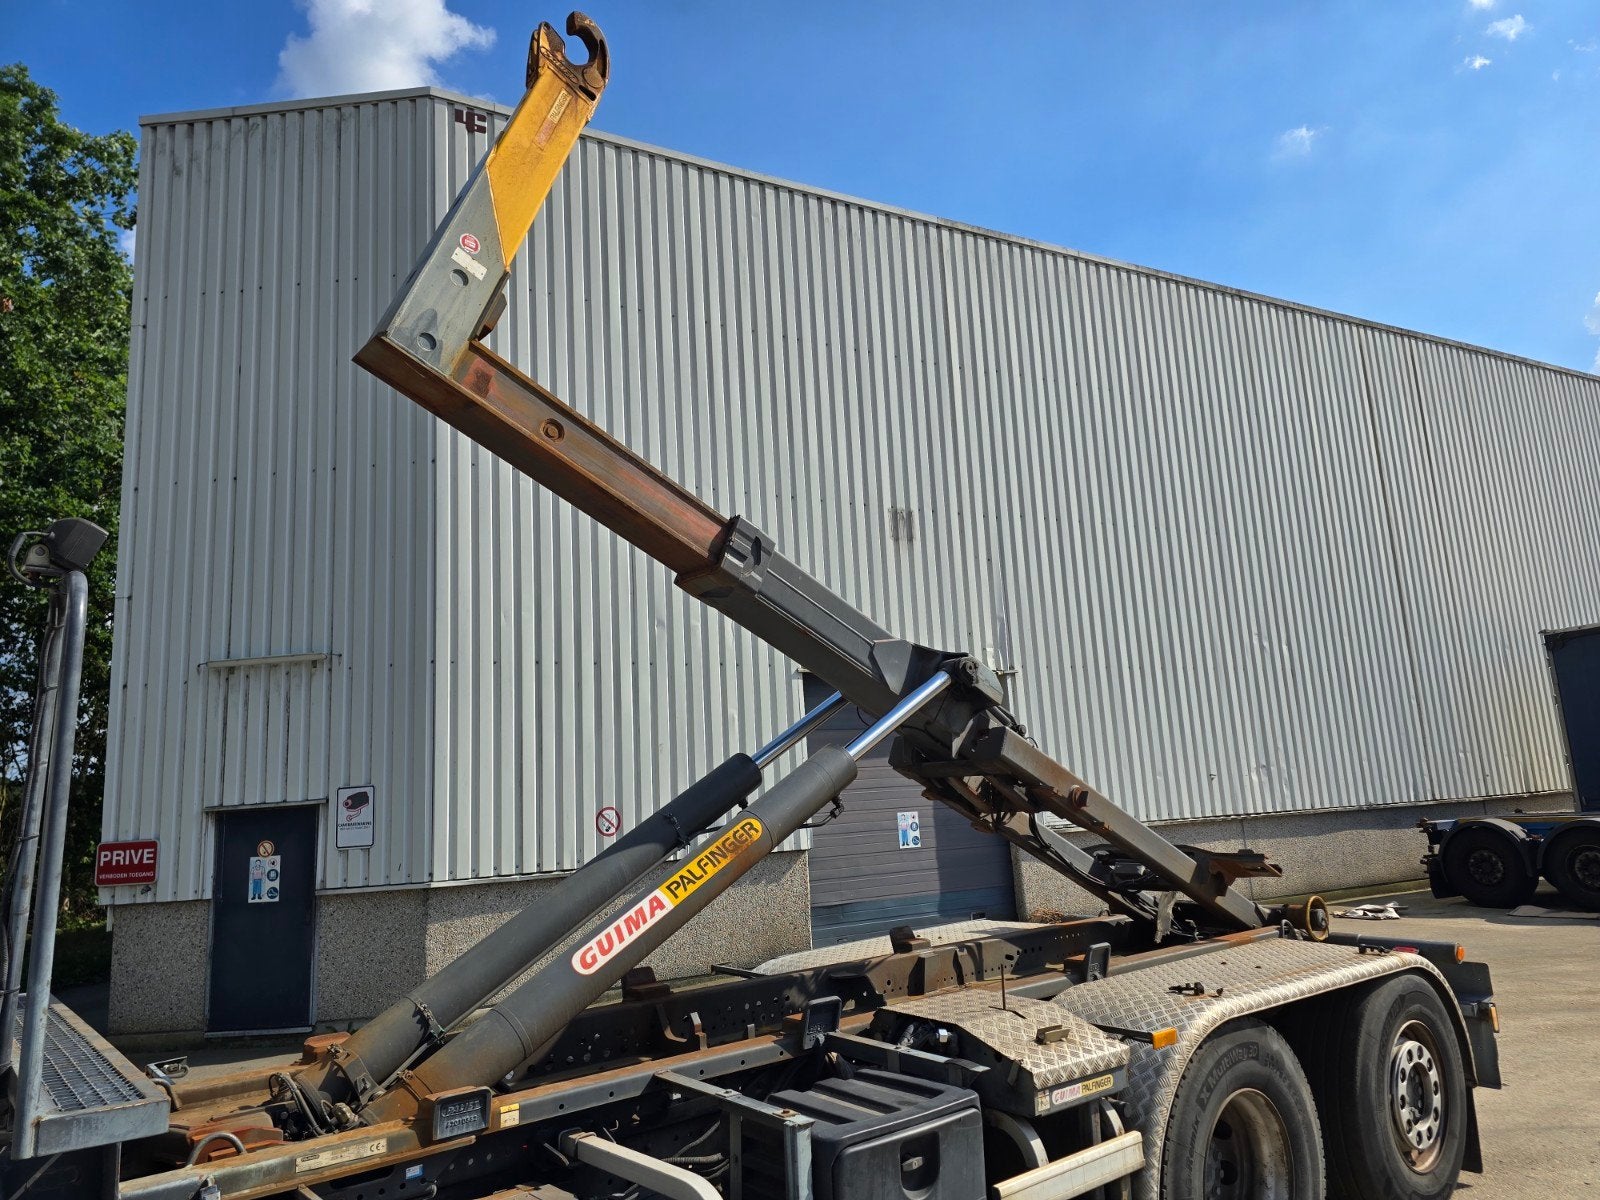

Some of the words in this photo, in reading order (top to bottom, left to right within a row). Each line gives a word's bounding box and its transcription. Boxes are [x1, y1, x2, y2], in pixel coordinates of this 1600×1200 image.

[100, 848, 155, 867] PRIVE
[99, 872, 128, 880] VERBODEN
[579, 894, 667, 970] GUIMA
[665, 821, 760, 900] PALFINGER
[1054, 1085, 1081, 1103] GUIMA
[1081, 1076, 1112, 1094] PALFINGER
